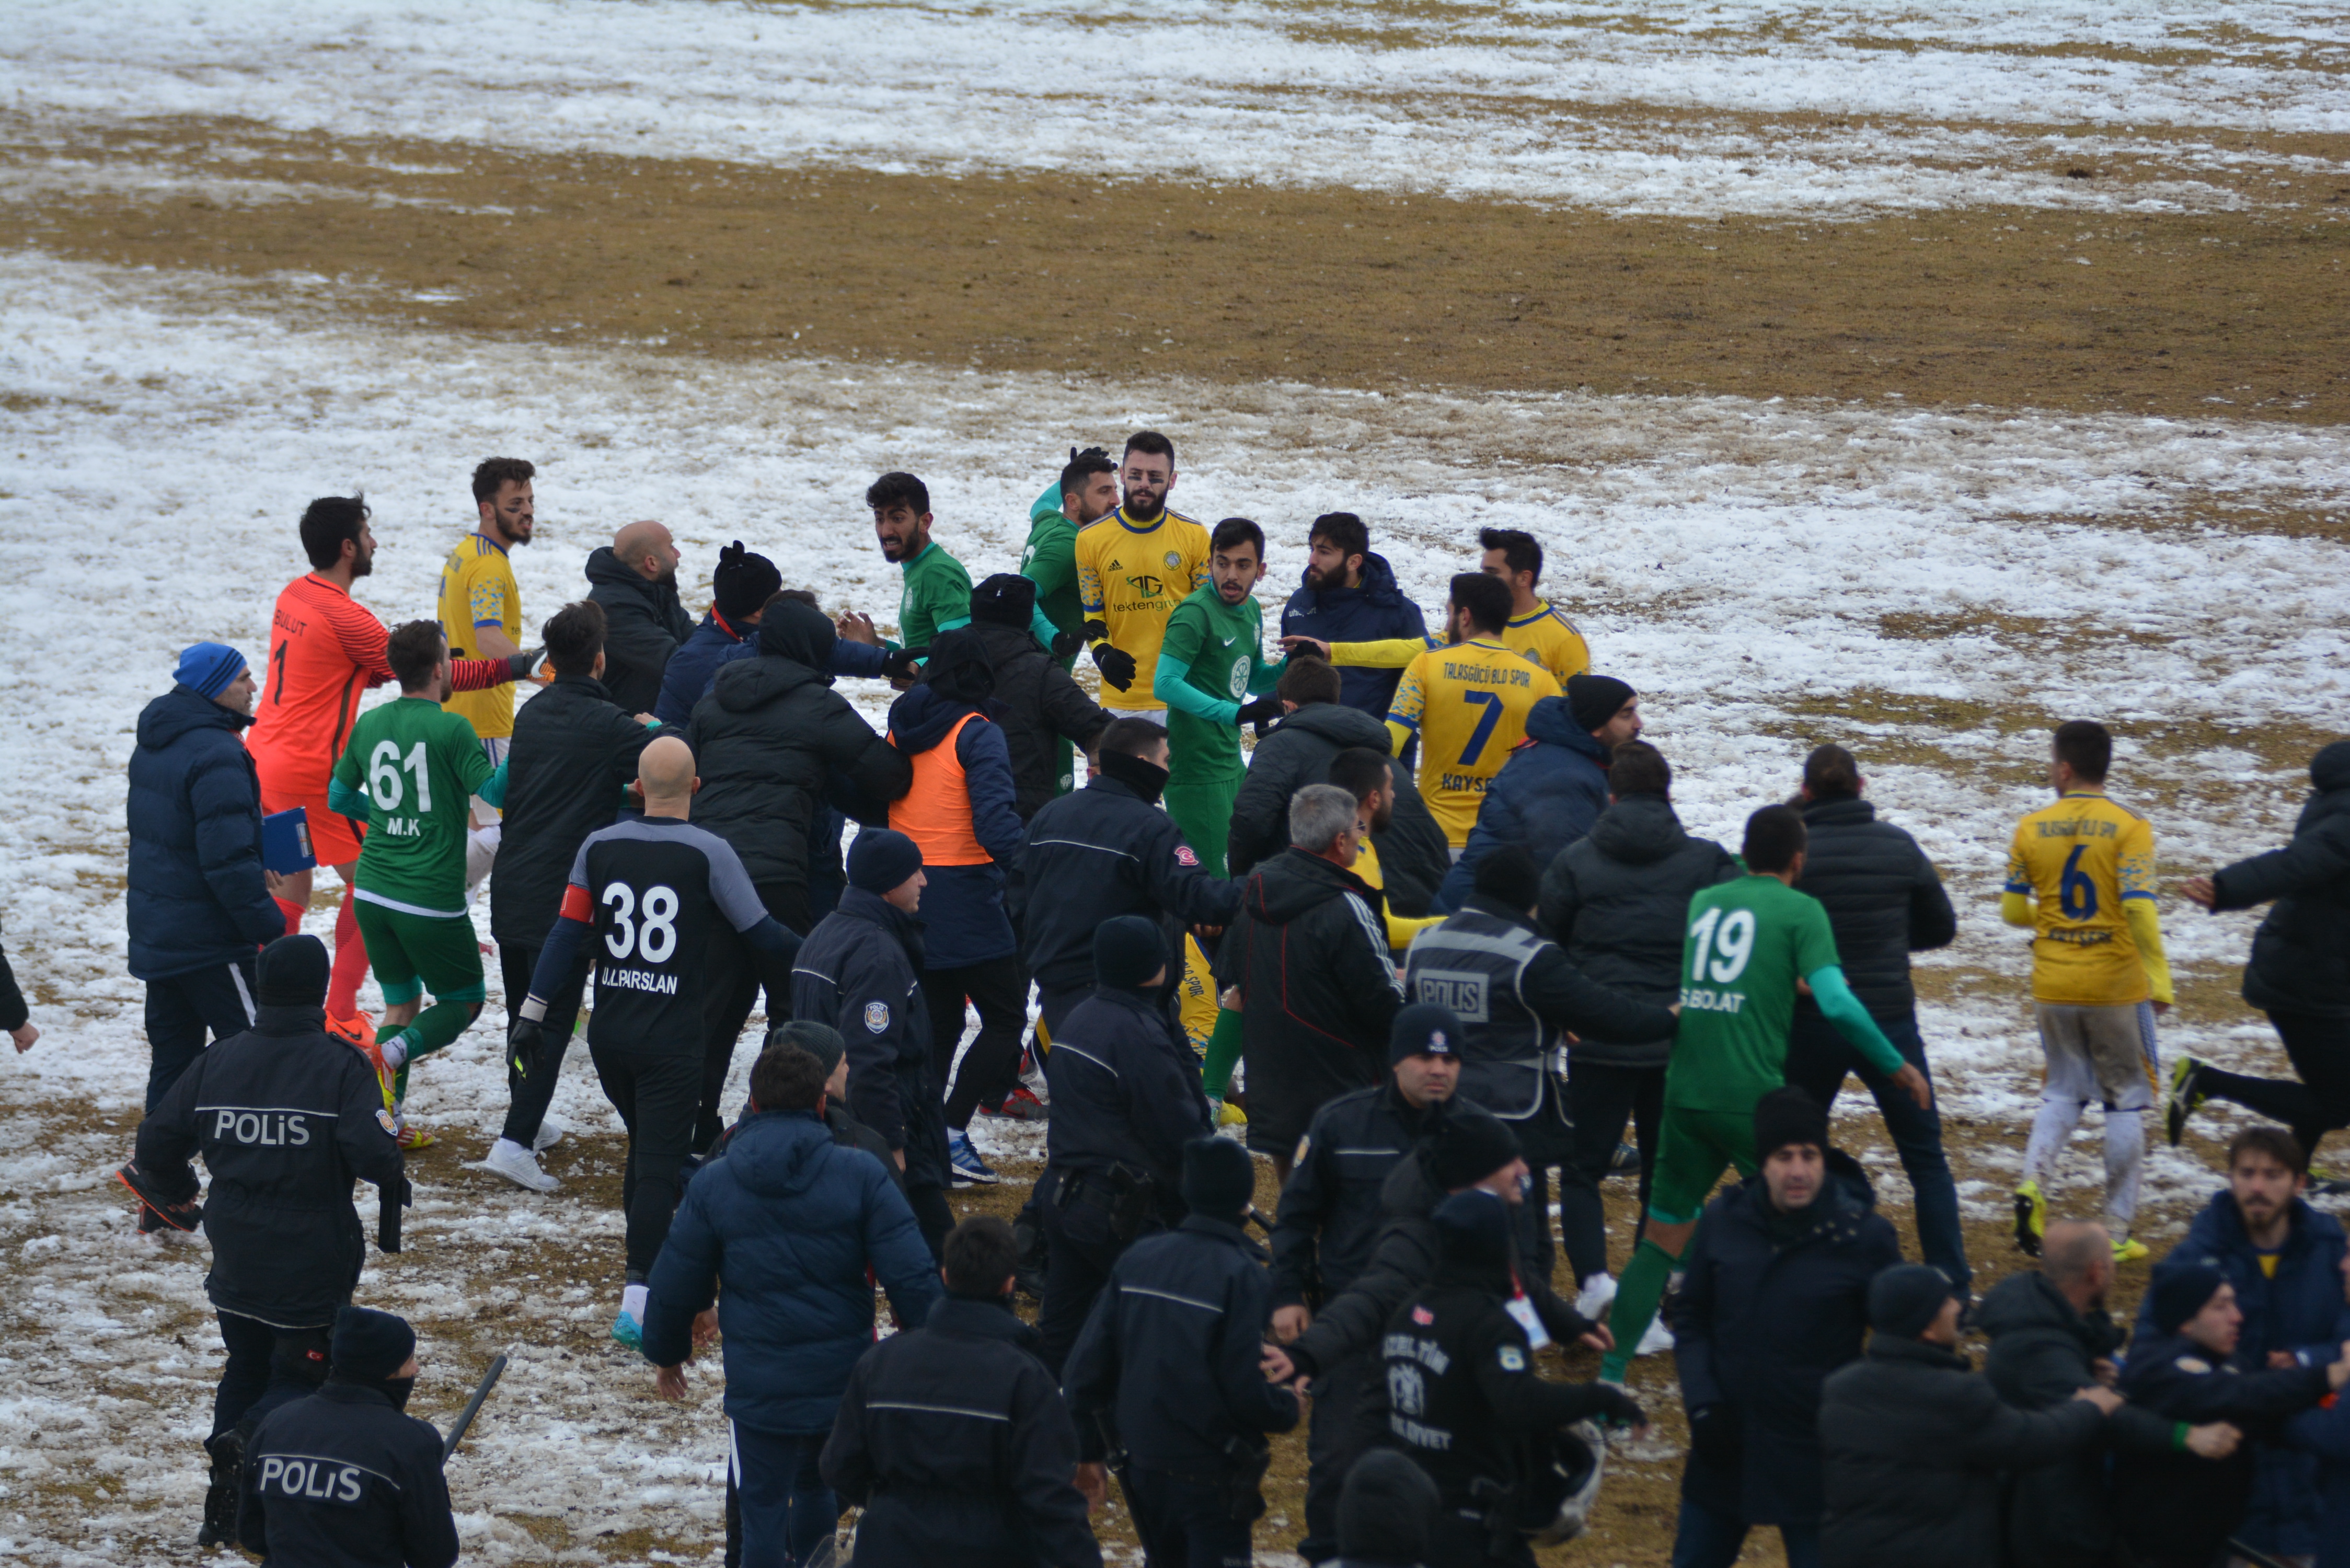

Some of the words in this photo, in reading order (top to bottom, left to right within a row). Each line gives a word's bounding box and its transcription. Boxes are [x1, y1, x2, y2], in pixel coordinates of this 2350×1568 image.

[274, 609, 307, 637] BULUT
[274, 639, 288, 706] 1
[1444, 662, 1490, 684] TALASGÜCÜ
[1491, 668, 1508, 685] BLD
[1510, 670, 1530, 688] SPOR
[1457, 689, 1504, 766] 7
[370, 740, 431, 812] 61
[387, 817, 421, 837] M.K
[2061, 845, 2098, 922] 6
[602, 882, 678, 963] 38
[1690, 907, 1756, 983] 19
[1184, 976, 1204, 997] SPOR
